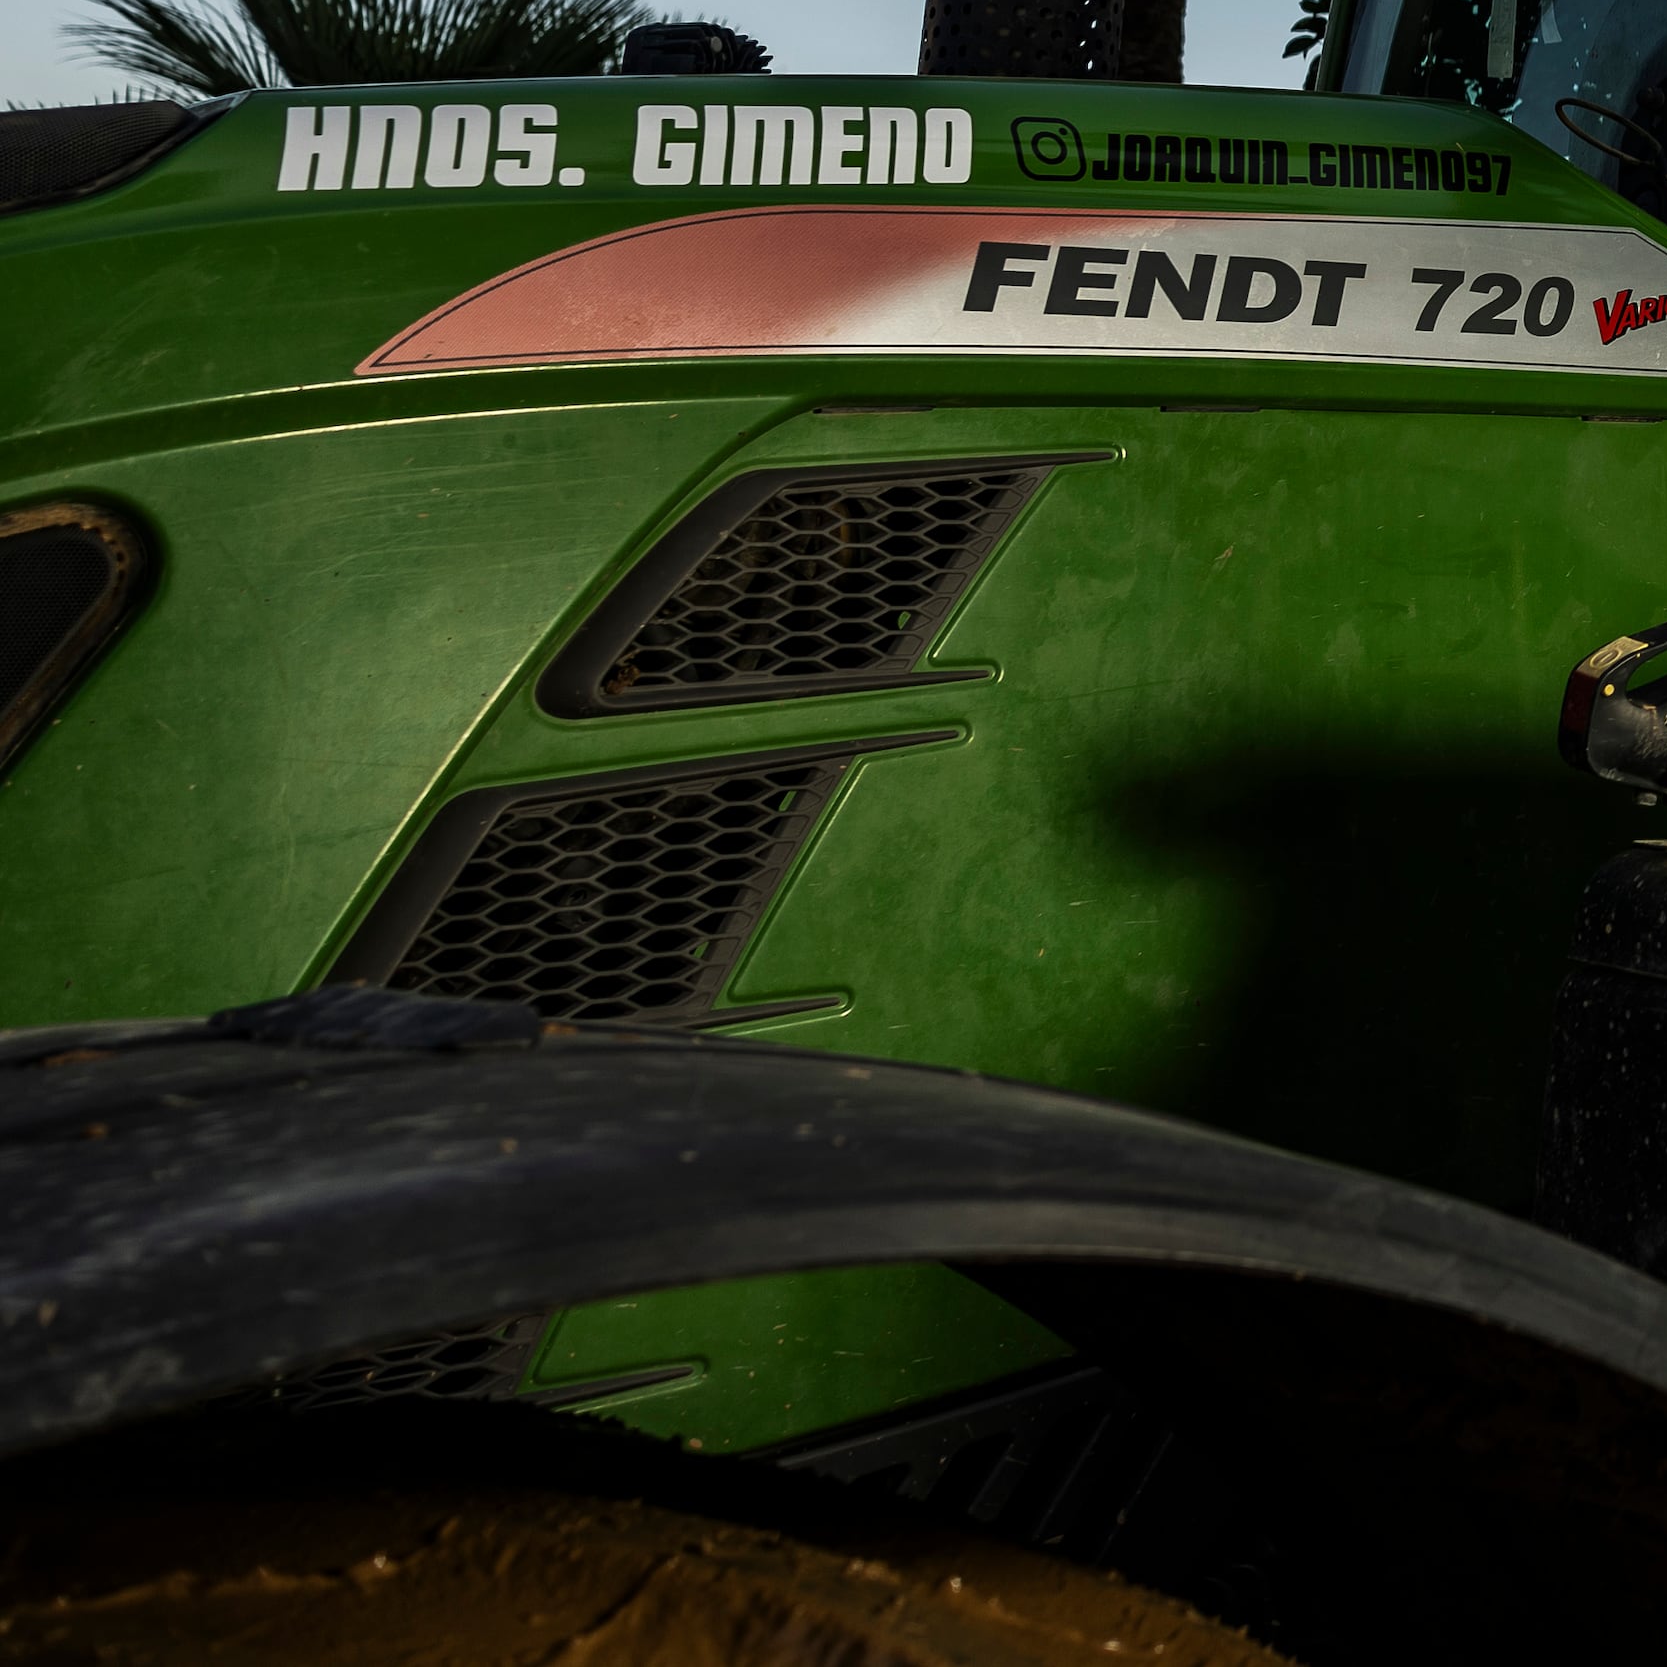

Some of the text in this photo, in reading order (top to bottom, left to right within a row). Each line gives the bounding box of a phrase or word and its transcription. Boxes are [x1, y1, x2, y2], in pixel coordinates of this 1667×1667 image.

[276, 103, 974, 192] HNOS. GIMENO
[1092, 133, 1512, 196] JOAQUIN_GIMENO97
[963, 241, 1367, 327] FENDT
[1411, 268, 1576, 338] 720
